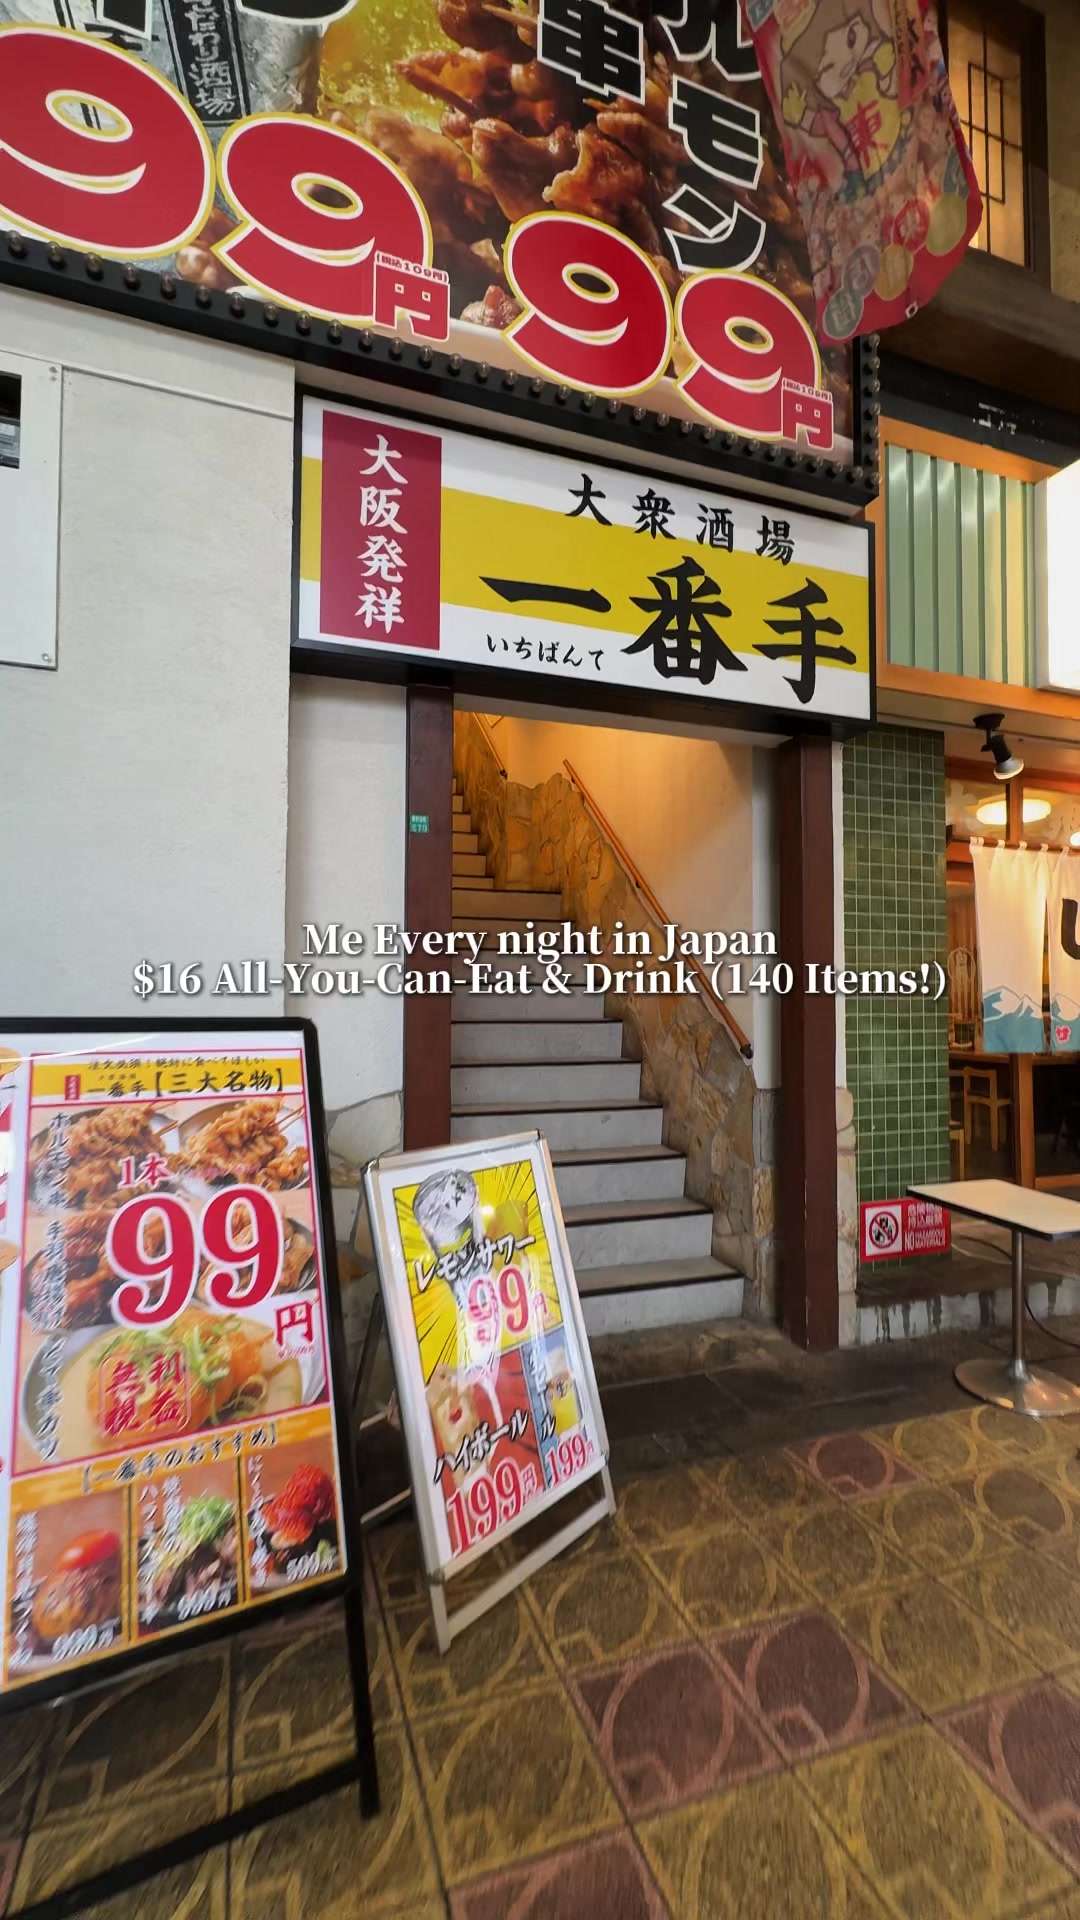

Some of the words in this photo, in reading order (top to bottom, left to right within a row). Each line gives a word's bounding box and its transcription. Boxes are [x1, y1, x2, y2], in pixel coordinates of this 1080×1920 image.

[356, 433, 409, 634] 大阪発祥
[567, 473, 796, 567] 大衆酒場
[478, 556, 859, 704] 一番手
[485, 633, 605, 672] いちばんて
[413, 1232, 537, 1293] レモンサワー
[432, 1407, 529, 1484] ハイボール
